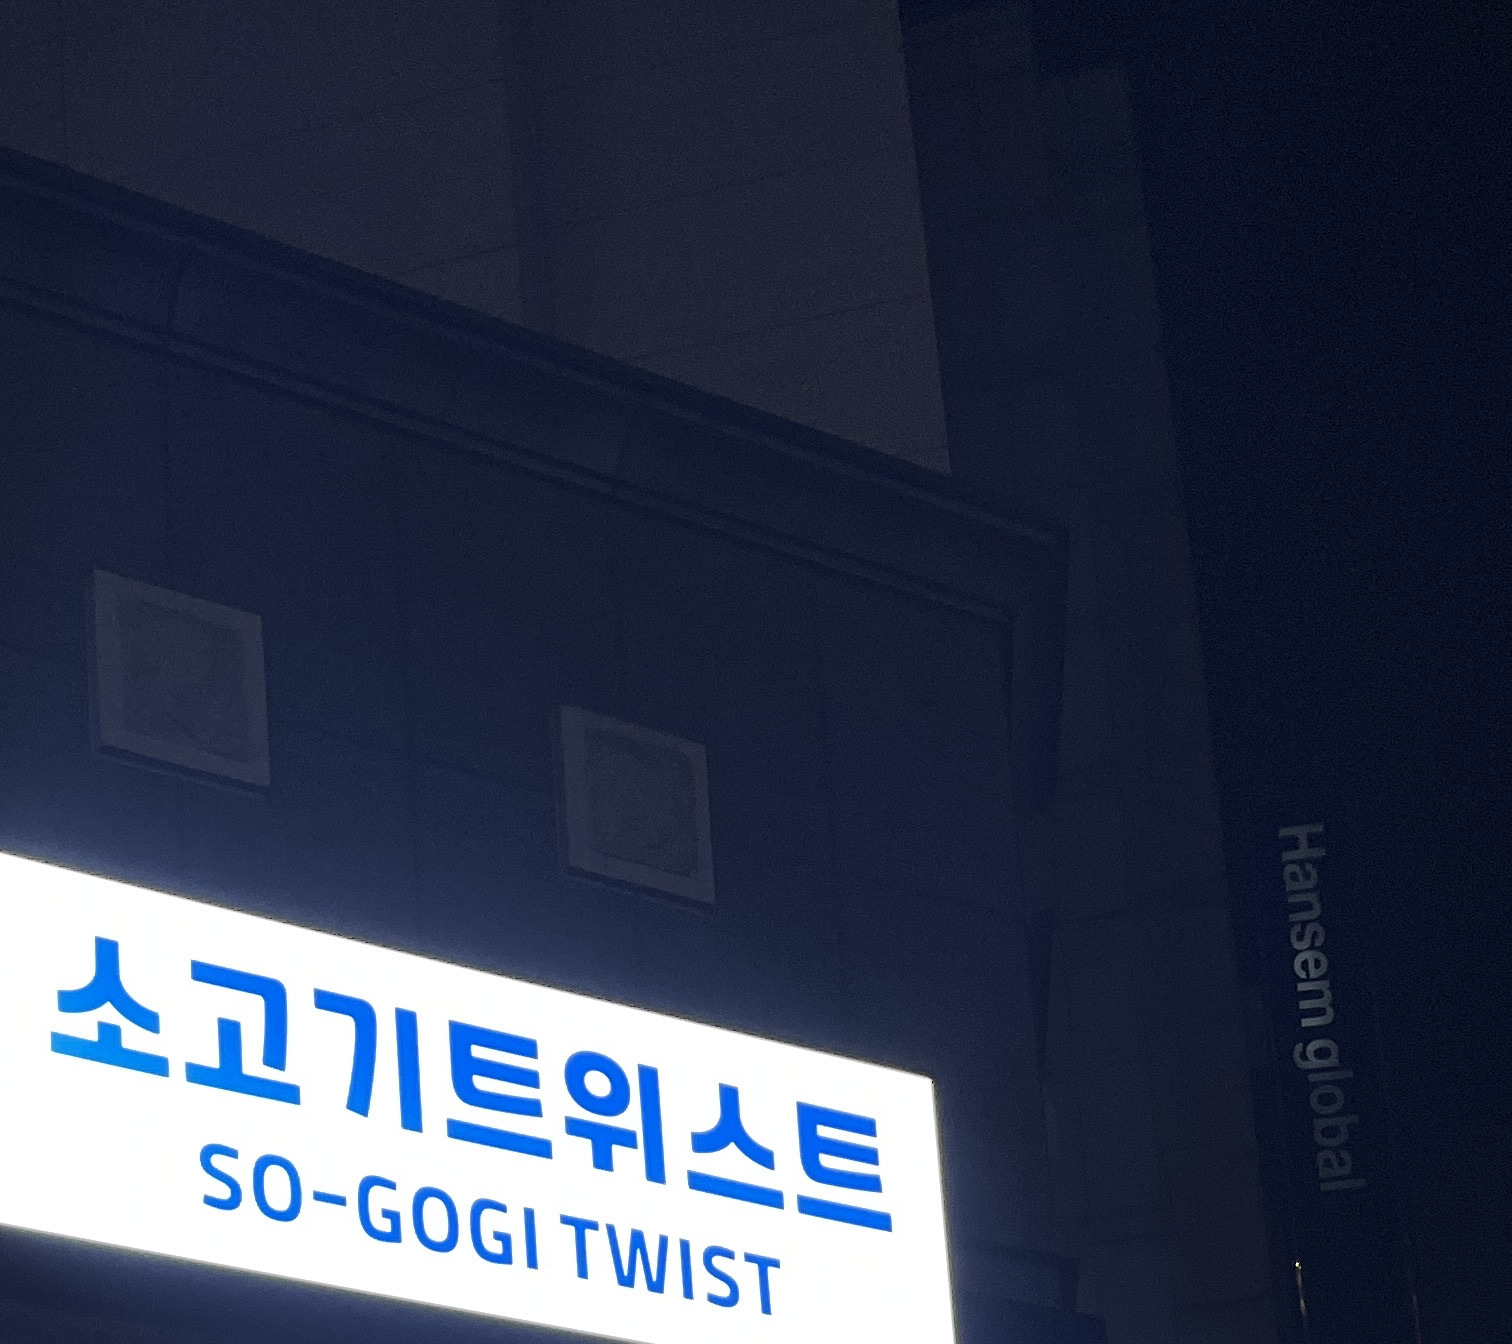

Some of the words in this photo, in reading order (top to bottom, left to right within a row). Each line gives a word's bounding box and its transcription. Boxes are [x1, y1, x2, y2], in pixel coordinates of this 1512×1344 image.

[1278, 822, 1336, 1027] Hansem
[49, 935, 893, 1232] 소고기트위스트
[1292, 1038, 1367, 1192] global
[198, 1142, 539, 1270] SO-GOGI
[559, 1212, 782, 1316] TWIST
